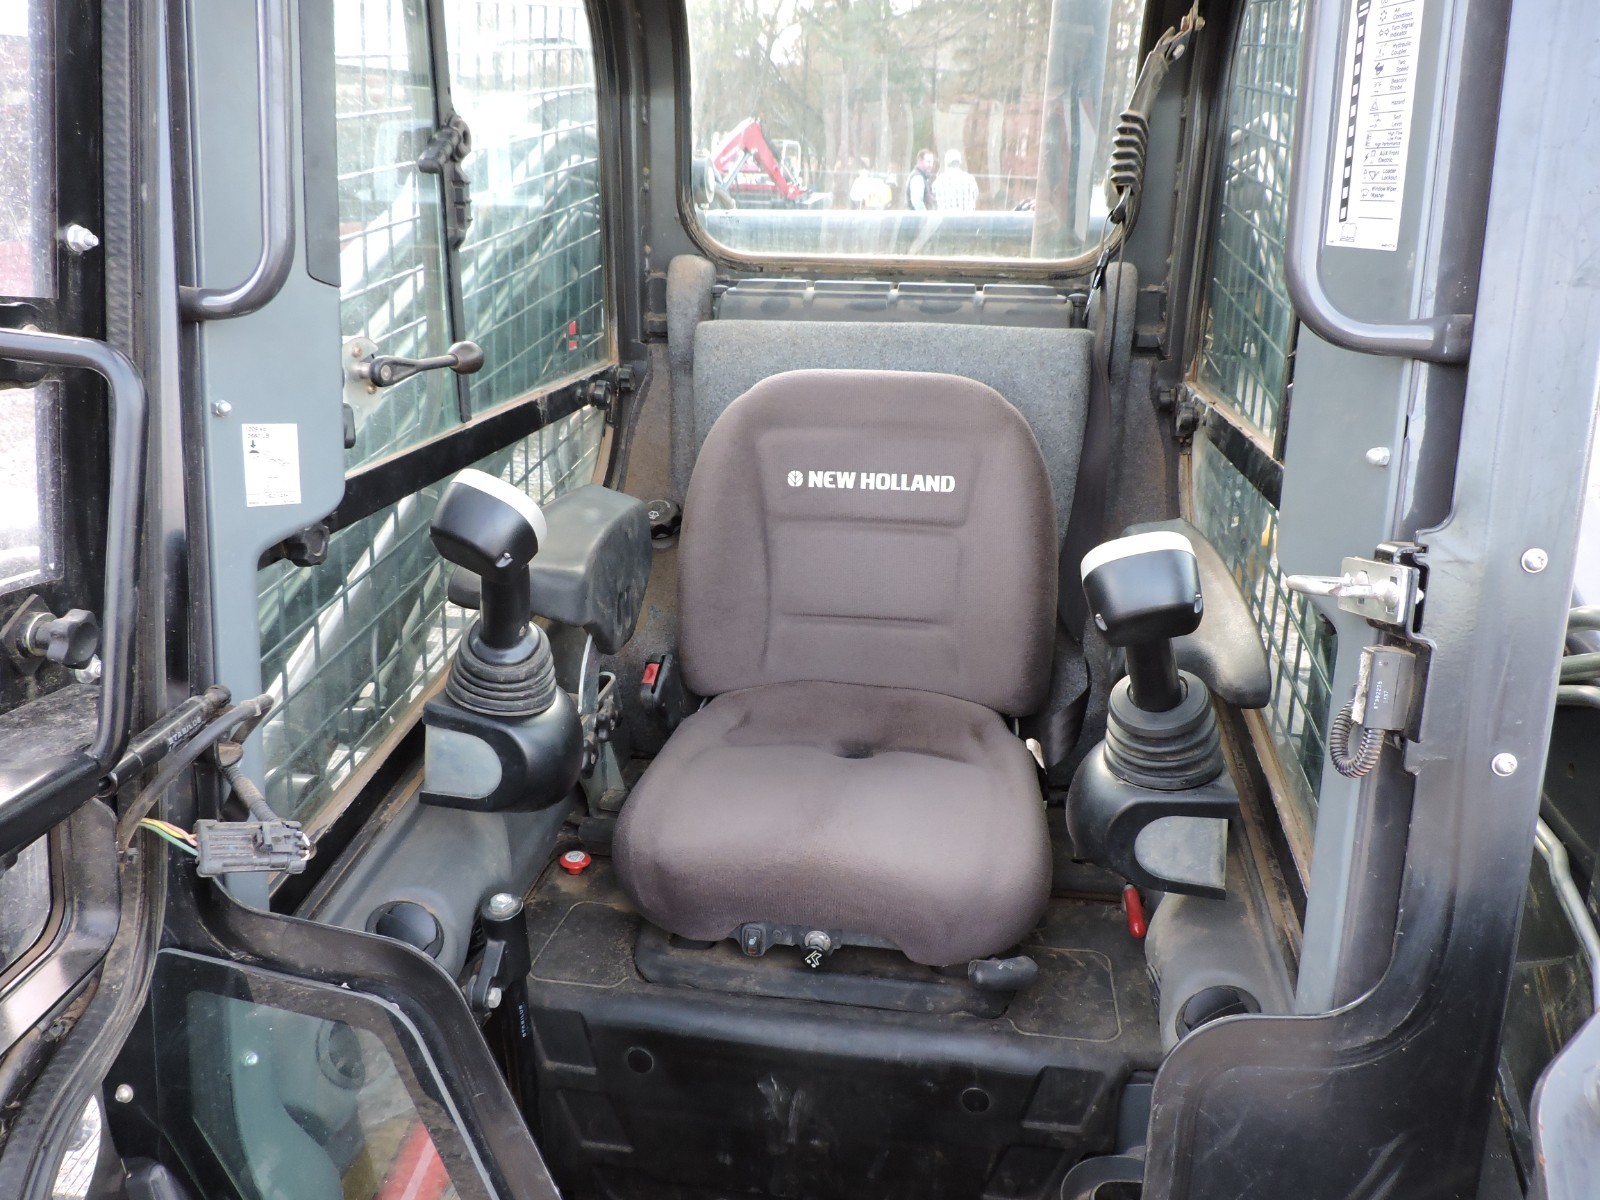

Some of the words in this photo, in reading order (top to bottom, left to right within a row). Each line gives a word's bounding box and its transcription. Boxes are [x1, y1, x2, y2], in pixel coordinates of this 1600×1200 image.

[1401, 21, 1414, 29] Signal
[1392, 41, 1412, 49] Hydraulic
[1391, 48, 1407, 56] Coupler
[1396, 65, 1409, 73] Speed
[808, 471, 856, 489] NEW
[860, 473, 955, 493] HOLLAND
